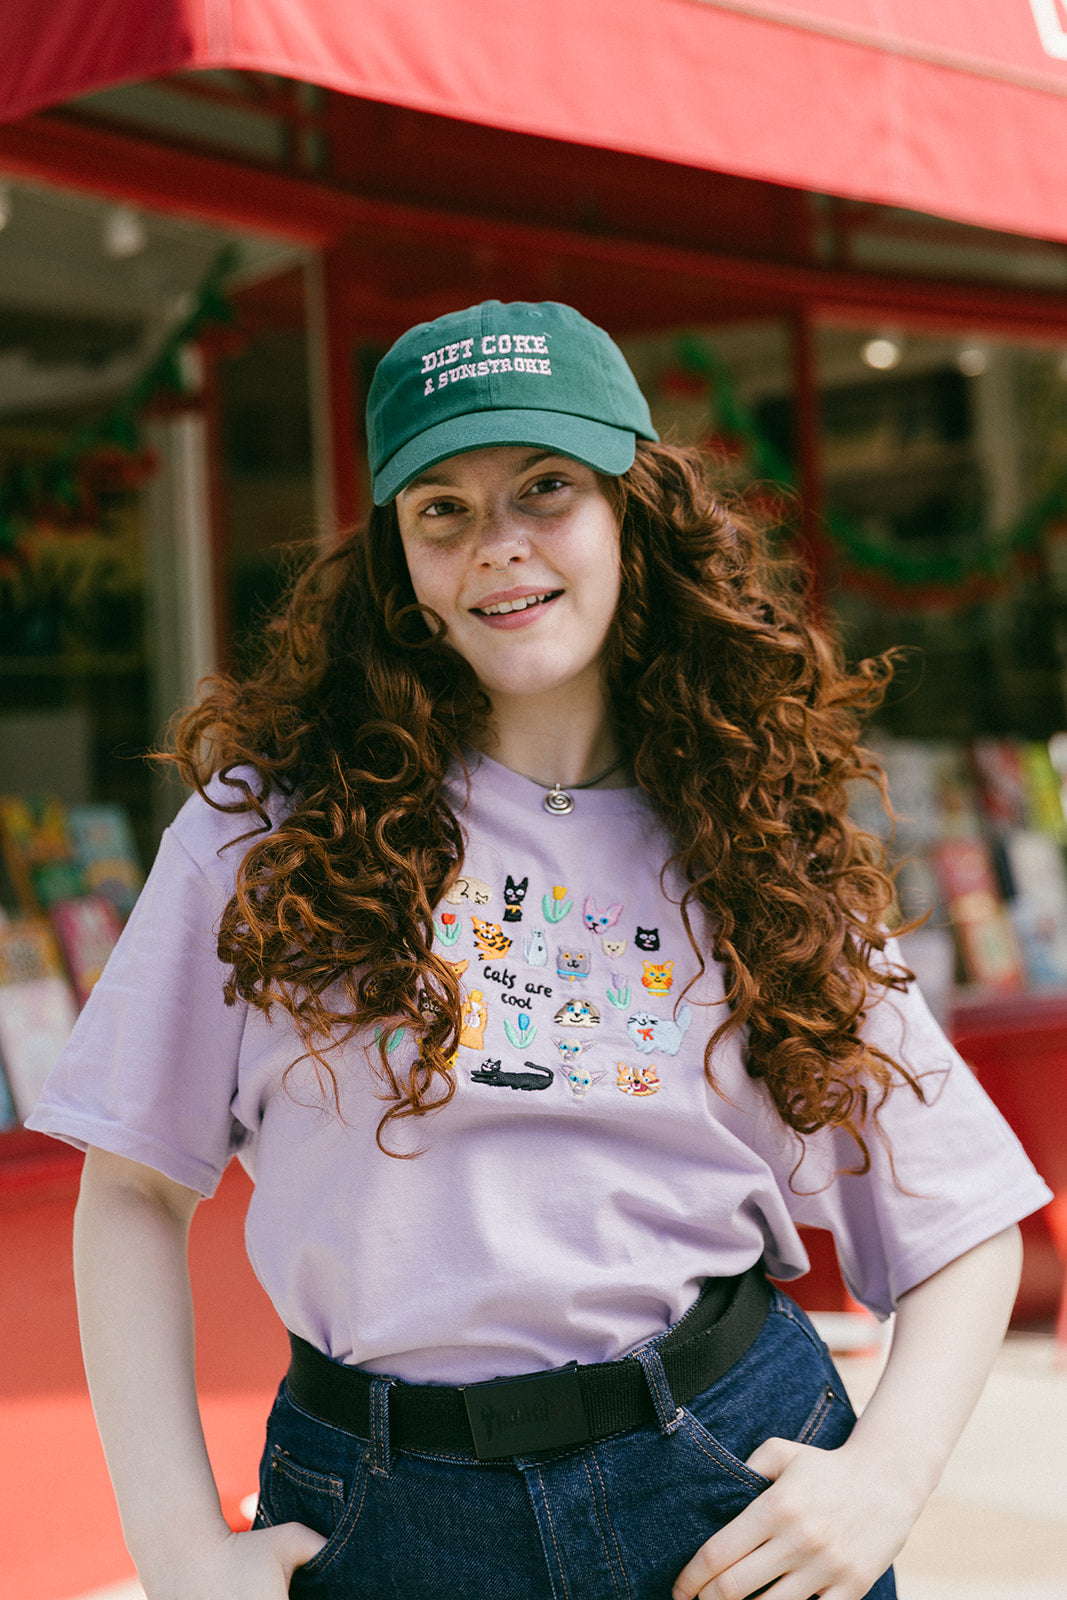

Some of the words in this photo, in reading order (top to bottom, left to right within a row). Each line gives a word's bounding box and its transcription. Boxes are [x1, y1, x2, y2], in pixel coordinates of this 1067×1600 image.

[421, 338, 474, 374] DIET
[481, 334, 549, 355] COKE
[424, 378, 435, 396] &
[438, 357, 552, 389] SUNSTROKE
[483, 966, 516, 989] cats
[525, 983, 552, 997] are
[501, 993, 532, 1009] cool
